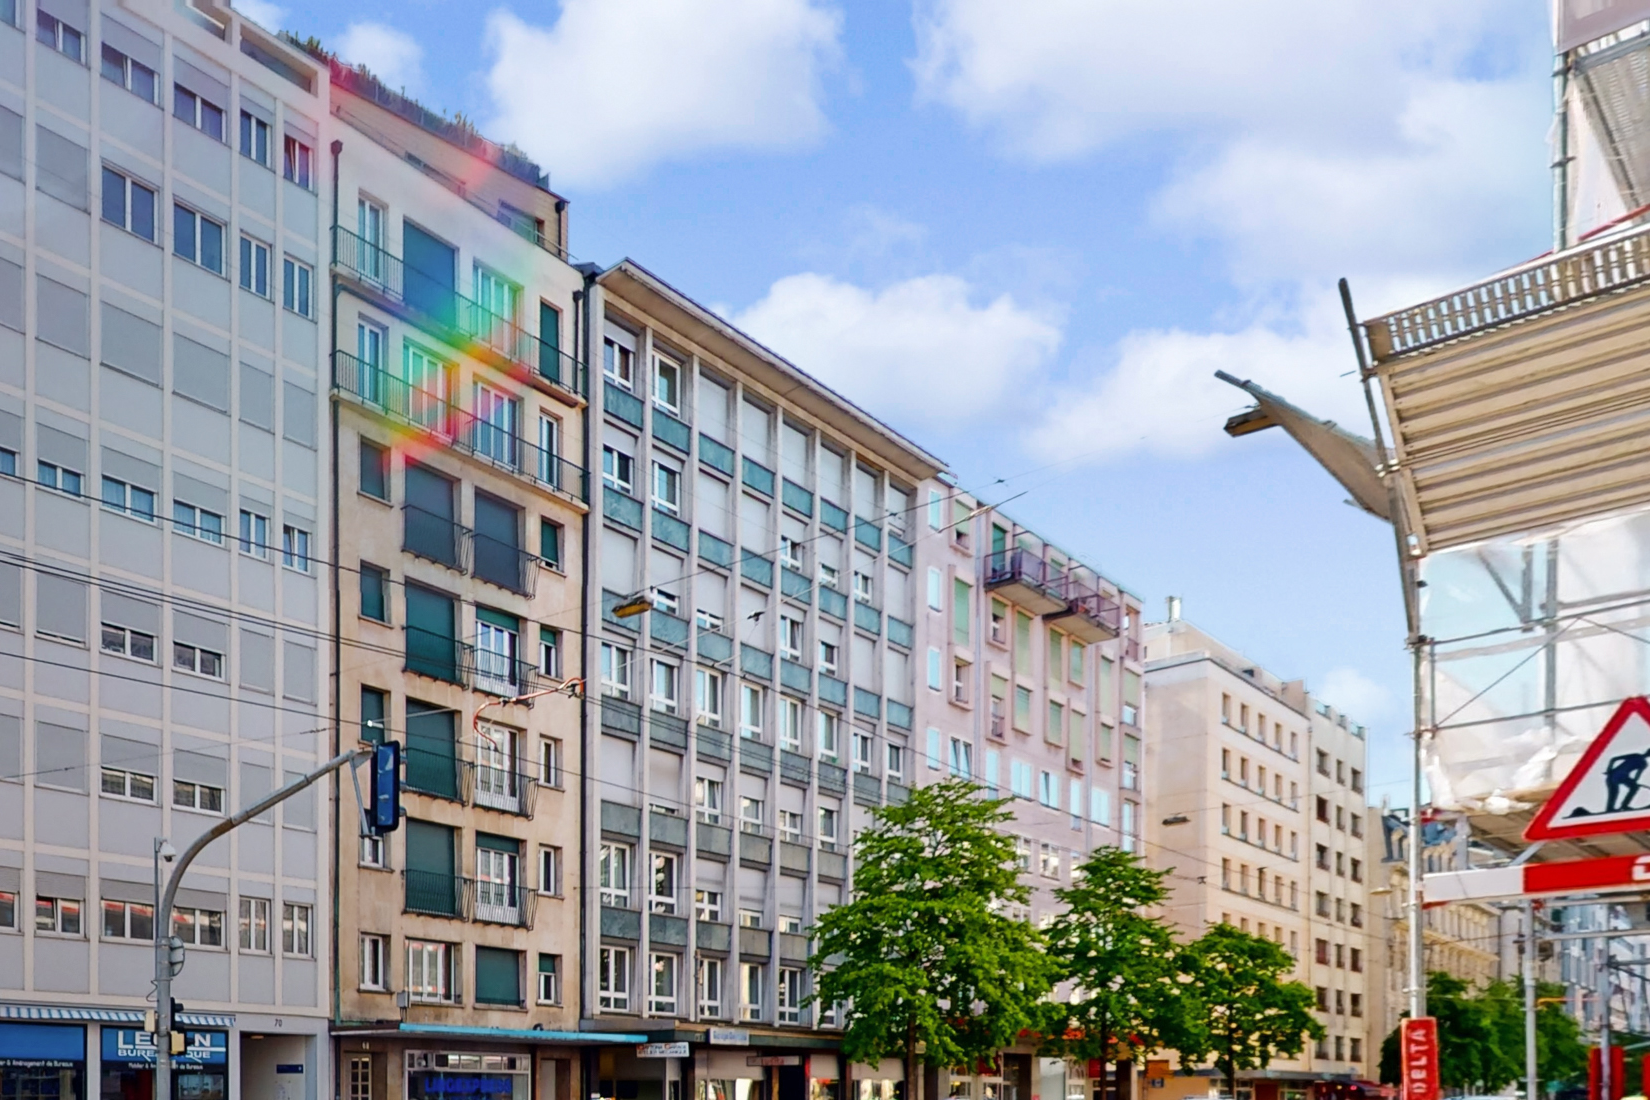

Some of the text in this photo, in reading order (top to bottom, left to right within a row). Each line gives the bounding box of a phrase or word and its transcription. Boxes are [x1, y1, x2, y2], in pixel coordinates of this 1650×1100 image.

[274, 1018, 283, 1027] 70
[117, 1031, 211, 1049] LEN
[1410, 1028, 1428, 1094] DELTA
